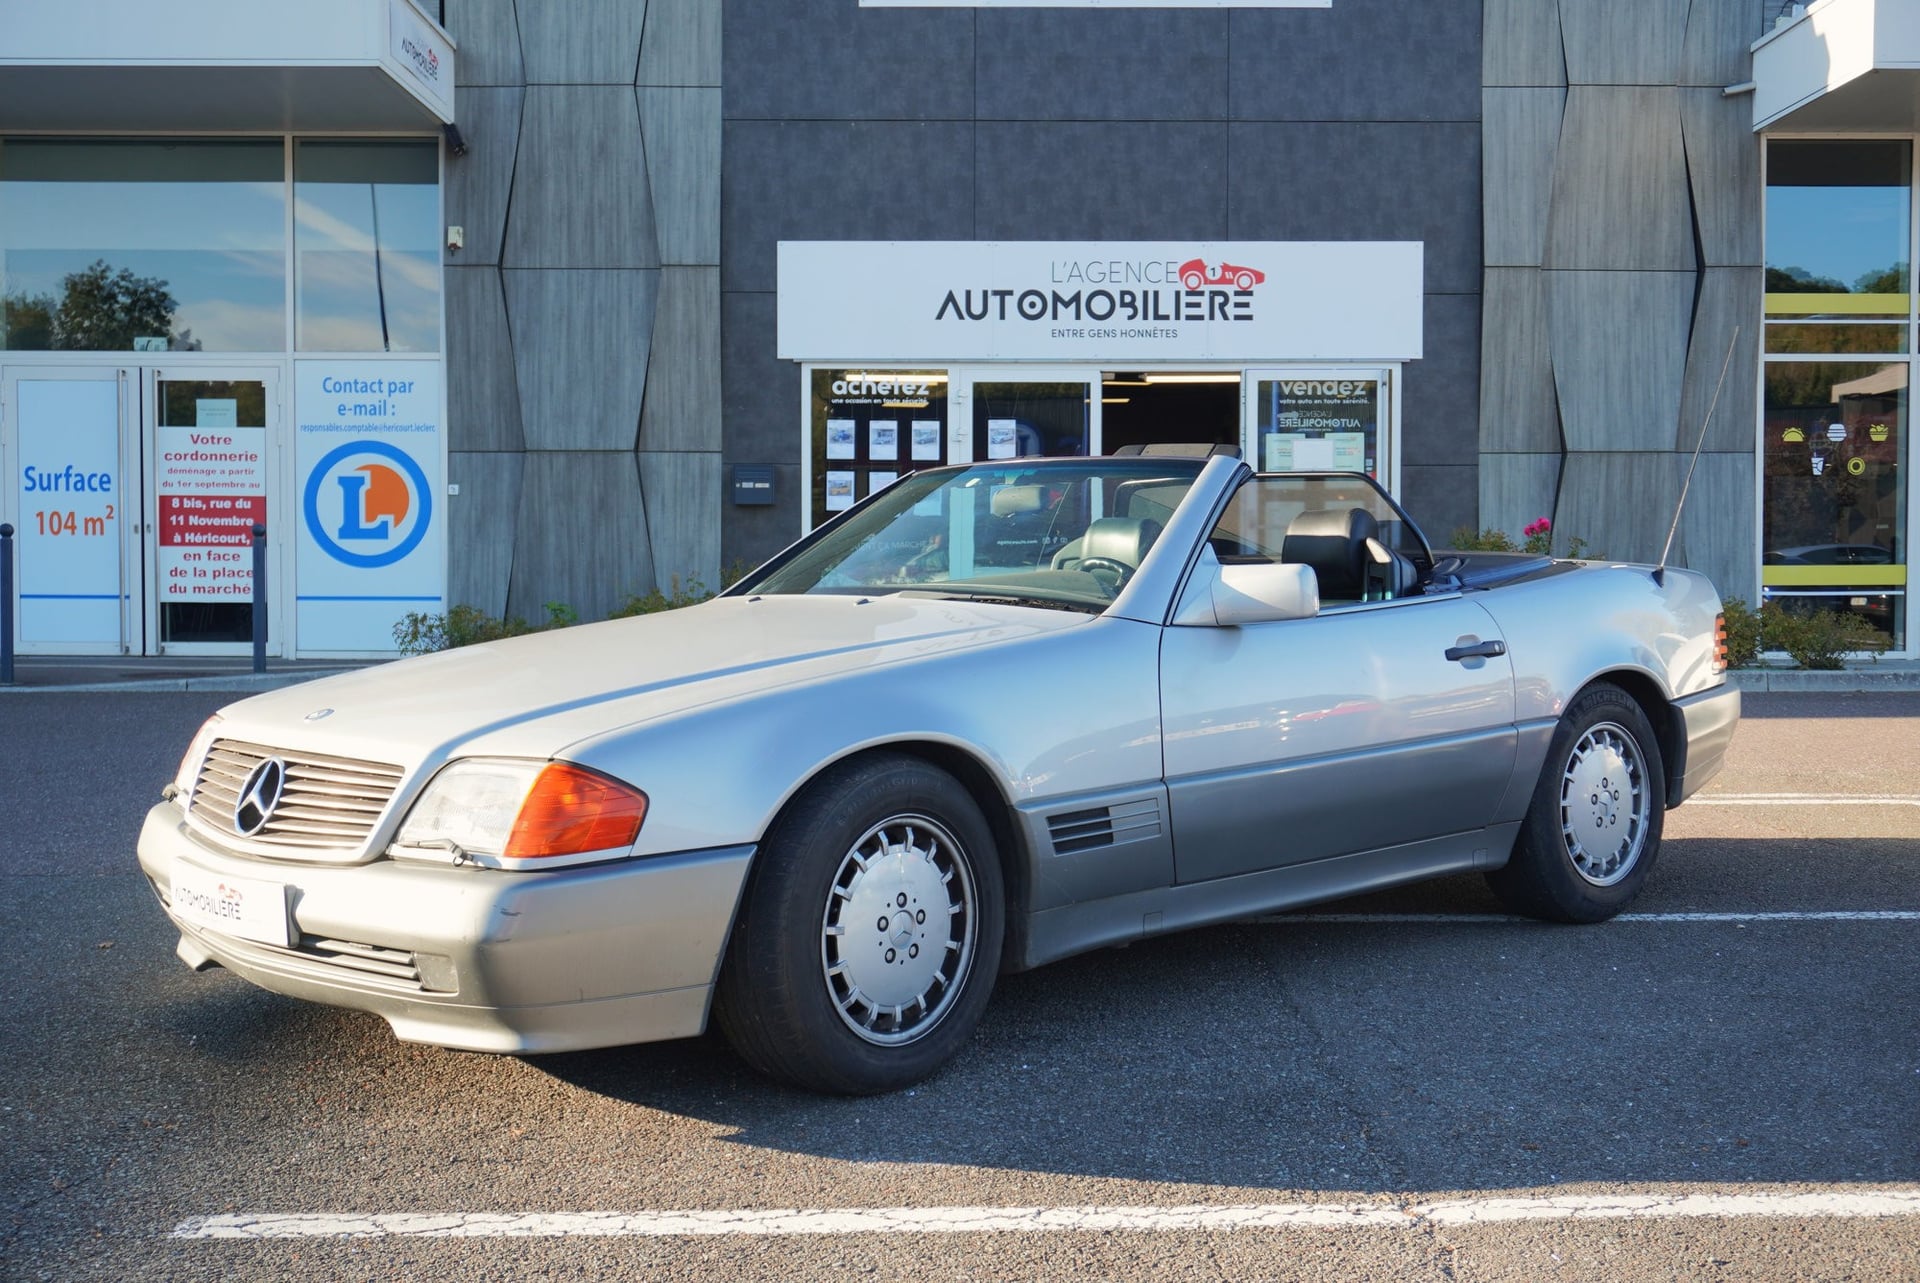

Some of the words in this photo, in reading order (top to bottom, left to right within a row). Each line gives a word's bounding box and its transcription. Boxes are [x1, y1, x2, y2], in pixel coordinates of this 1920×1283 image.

[1051, 261, 1179, 284] L'AGENCE
[1210, 267, 1217, 277] 1
[1051, 328, 1085, 338] ENTRE
[1088, 328, 1117, 338] GENS
[1120, 326, 1178, 338] HONNÊTES
[322, 377, 384, 393] Contact
[388, 380, 414, 397] par
[831, 372, 930, 396] achetez
[338, 399, 387, 416] e-mail
[190, 433, 232, 445] Votre
[164, 450, 258, 462] cordonnerie
[228, 467, 255, 476] partir
[24, 465, 111, 492] Surface
[162, 480, 174, 488] du
[177, 480, 192, 488] 1er
[195, 480, 246, 489] septembre
[171, 497, 180, 508] 8
[183, 497, 206, 510] bis,
[210, 499, 231, 509] rue
[235, 498, 252, 509] du
[36, 510, 77, 536] 104
[170, 514, 184, 526] 11
[188, 515, 254, 526] Novembre
[173, 532, 181, 543] à
[185, 532, 251, 545] Héricourt,
[183, 552, 201, 561] en
[207, 550, 241, 561] face
[169, 566, 187, 577] de
[193, 567, 207, 577] la
[212, 567, 253, 580] place
[169, 583, 187, 594] du
[193, 583, 251, 594] marché
